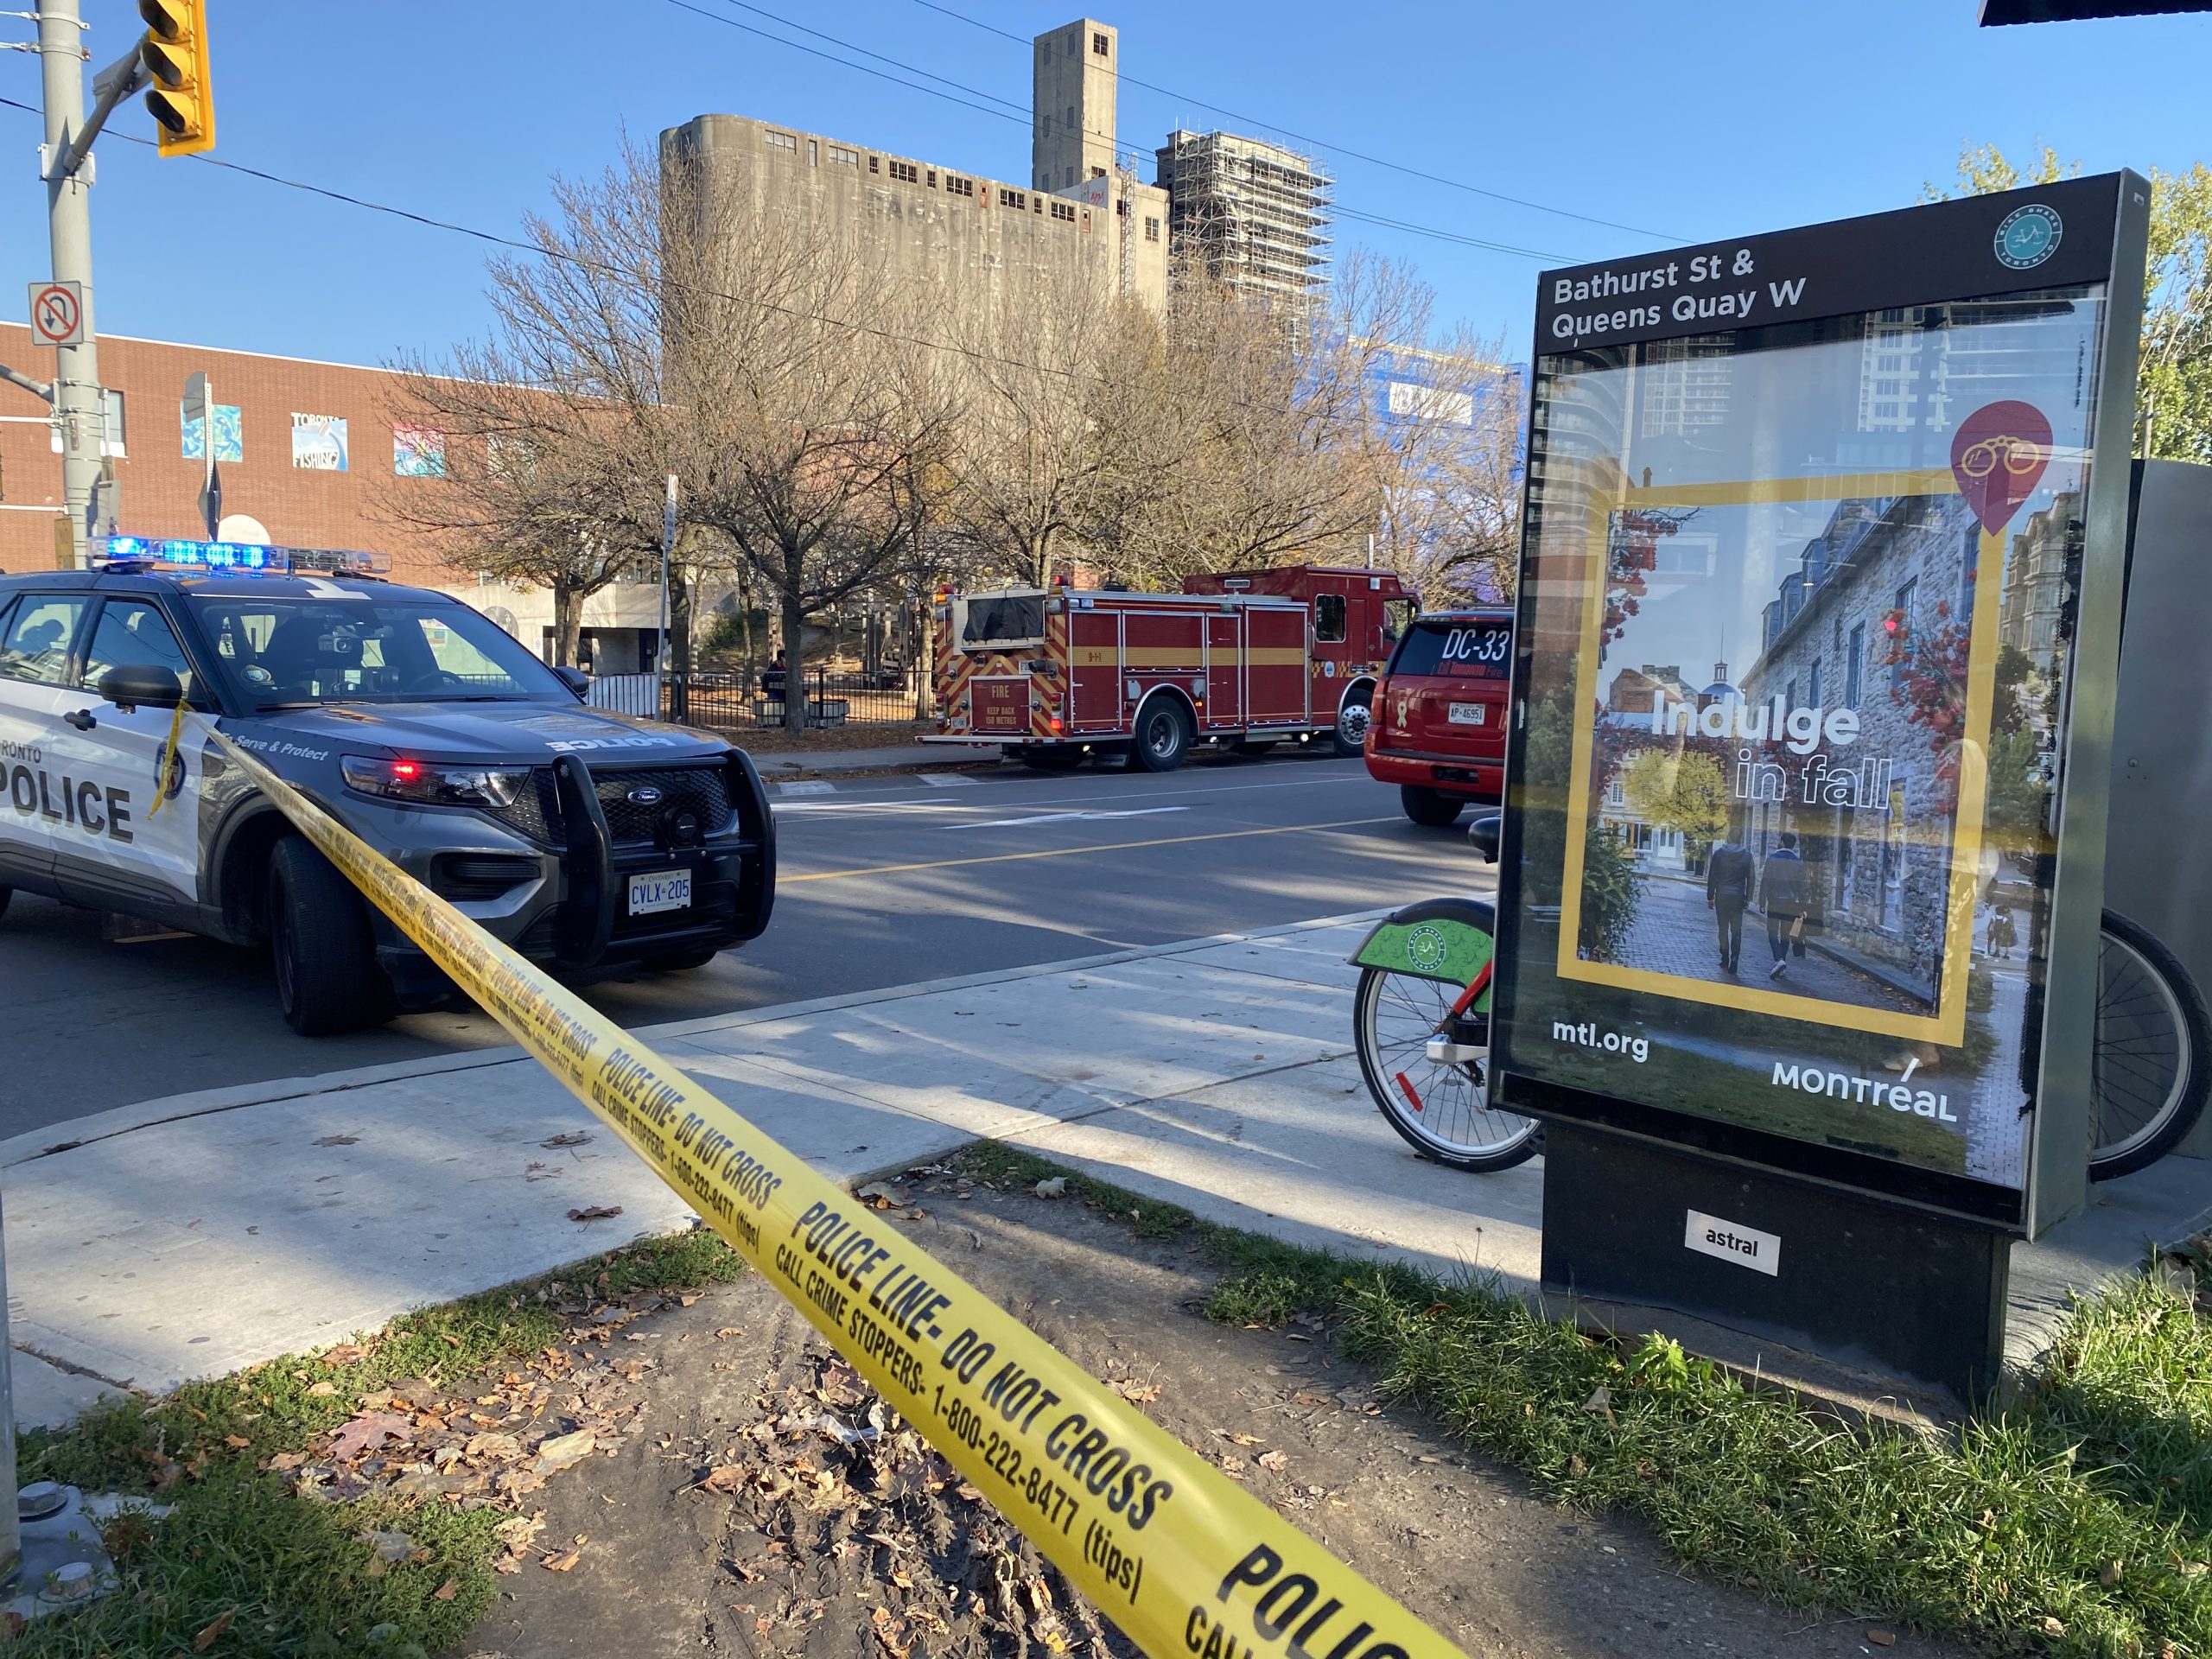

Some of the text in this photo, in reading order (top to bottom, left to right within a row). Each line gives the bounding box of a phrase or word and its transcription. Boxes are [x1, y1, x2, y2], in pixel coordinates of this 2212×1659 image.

[1999, 207, 2058, 235] BIKE SHARE
[1554, 248, 1754, 304] Bathurst St &
[2000, 245, 2054, 265] TORONTO
[1552, 276, 1807, 338] Queens Quay W
[292, 451, 340, 470] FISHING
[1442, 628, 1510, 661] DC-33
[986, 706, 1015, 715] KEEP BACK
[991, 684, 1010, 698] FIRE
[996, 716, 1017, 725] METRES
[1651, 690, 1859, 755] Indulge
[0, 739, 41, 764] RONTO
[233, 734, 268, 751] Serve
[269, 741, 281, 752] &
[280, 743, 329, 761] Protect
[1735, 747, 1893, 810] in fall
[668, 879, 690, 900] 205
[562, 1020, 598, 1062] CROSS
[1553, 1020, 1649, 1064] mtl.org
[592, 1080, 607, 1109] CALL
[607, 1094, 629, 1128] CRIME
[599, 1046, 783, 1211] POLICE LINE- DO NOT CROSS
[1705, 1225, 1758, 1257] astral
[790, 1200, 1175, 1532] POLICE LINE- DO NOT CROSS
[775, 1243, 1145, 1607] CALL CRIME STOPPERS- 1-800-222-8477 (tips)
[1216, 1542, 1411, 1659] POLI
[1185, 1605, 1254, 1659] CA
